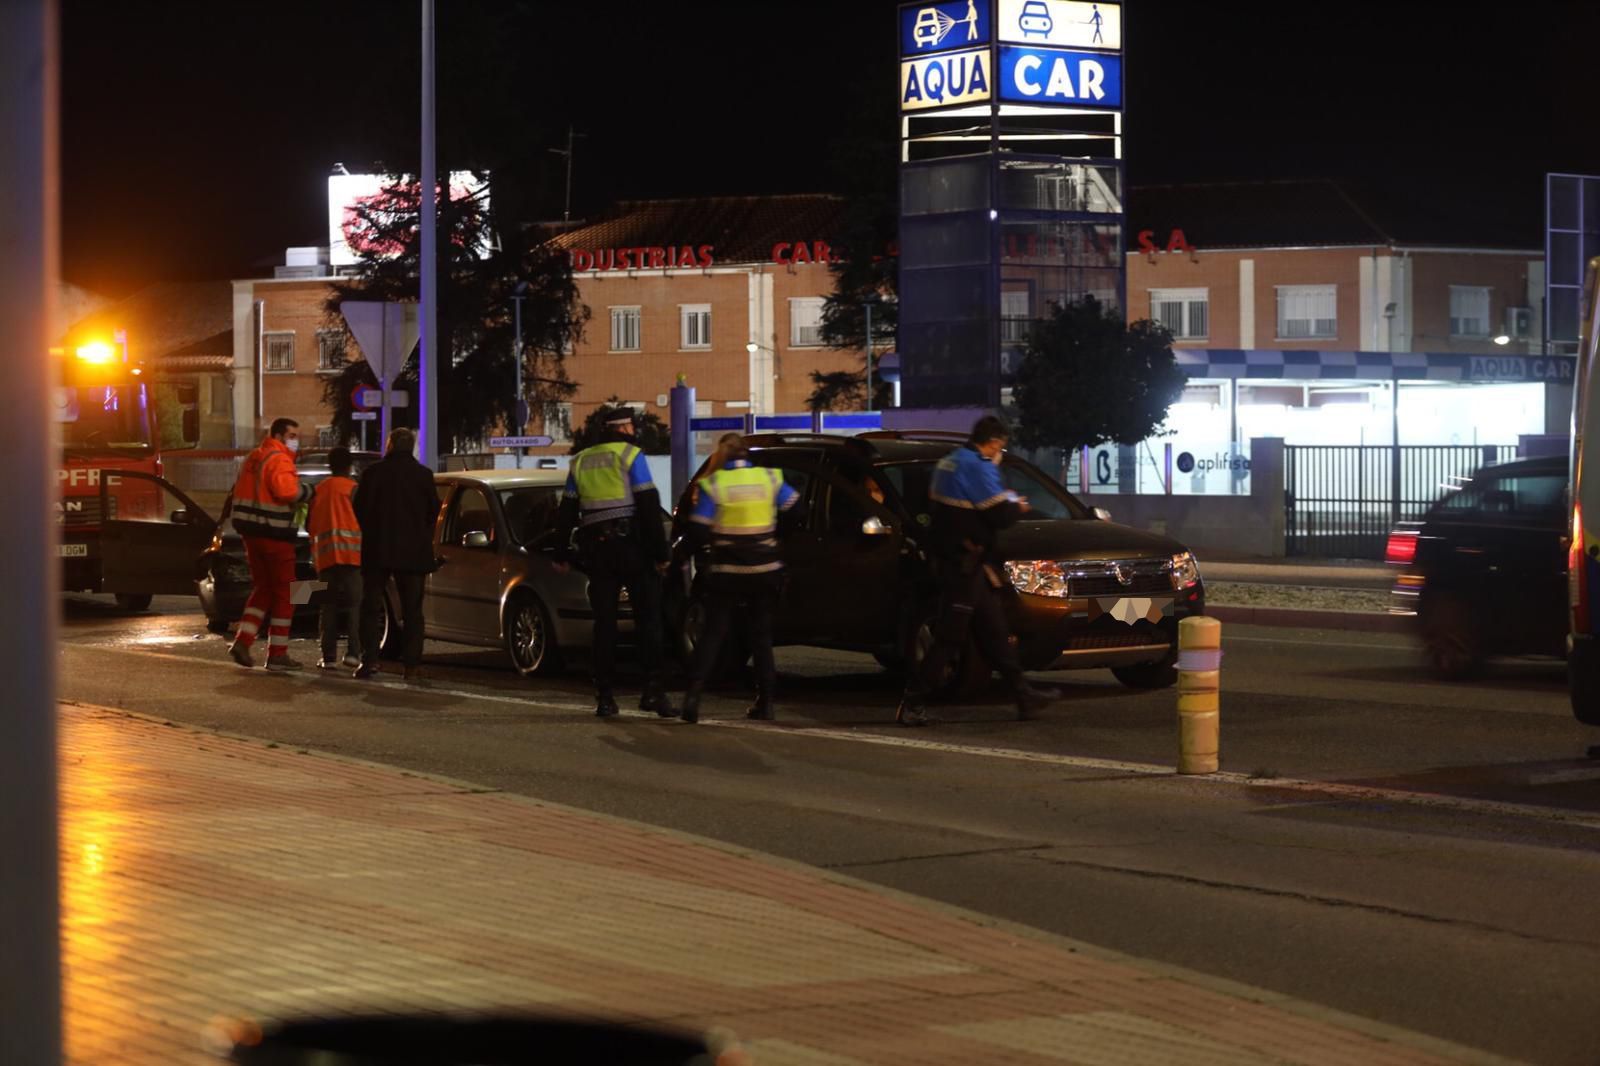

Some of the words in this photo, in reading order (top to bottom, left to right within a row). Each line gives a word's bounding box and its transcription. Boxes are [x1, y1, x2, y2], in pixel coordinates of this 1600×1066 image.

[904, 55, 988, 103] AQUA
[1014, 54, 1106, 100] CAR
[570, 243, 715, 271] DUSTRIAS
[770, 239, 848, 265] CAR
[1472, 359, 1523, 377] AQUA
[1532, 360, 1572, 379] CAR
